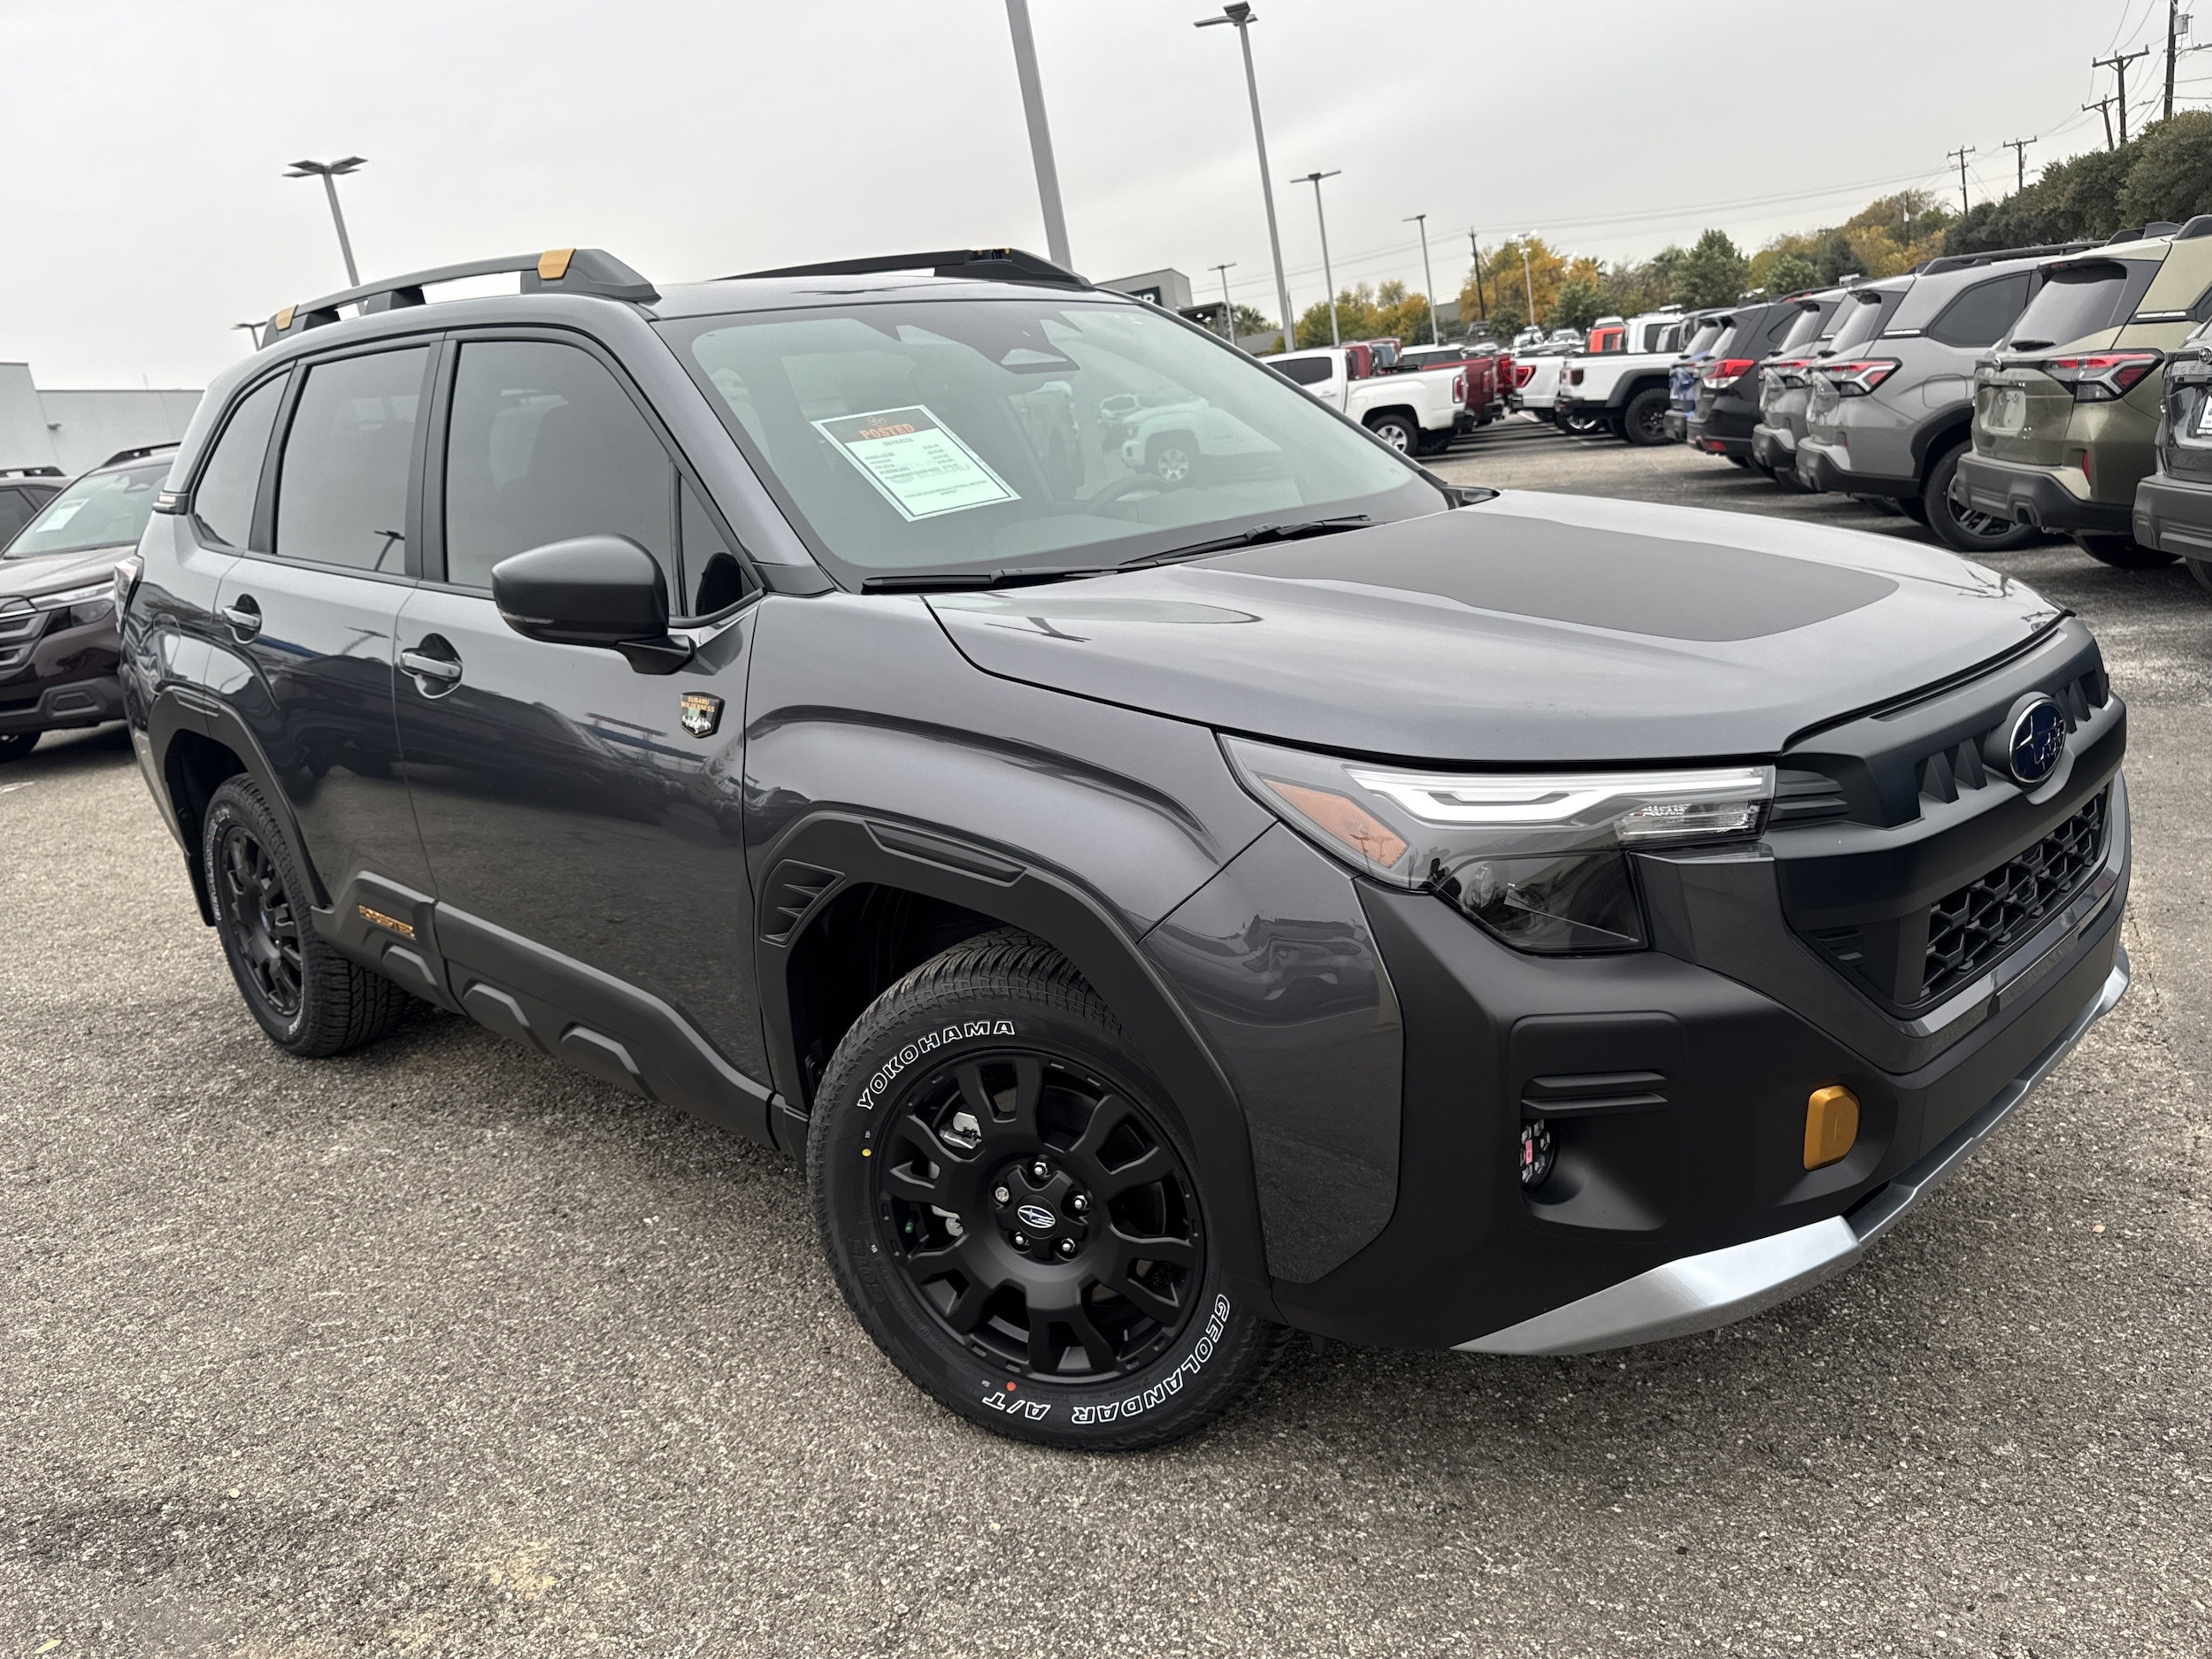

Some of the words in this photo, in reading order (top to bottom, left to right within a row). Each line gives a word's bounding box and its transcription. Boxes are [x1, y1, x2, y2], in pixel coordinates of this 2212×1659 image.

[859, 423, 916, 440] POSTED
[681, 701, 715, 713] WILDERNESS
[687, 695, 710, 706] SUBARU
[856, 1020, 1016, 1110] YOKOHAMA
[1071, 1294, 1231, 1425] GEOLANDAR
[981, 1392, 1051, 1421] A/T
